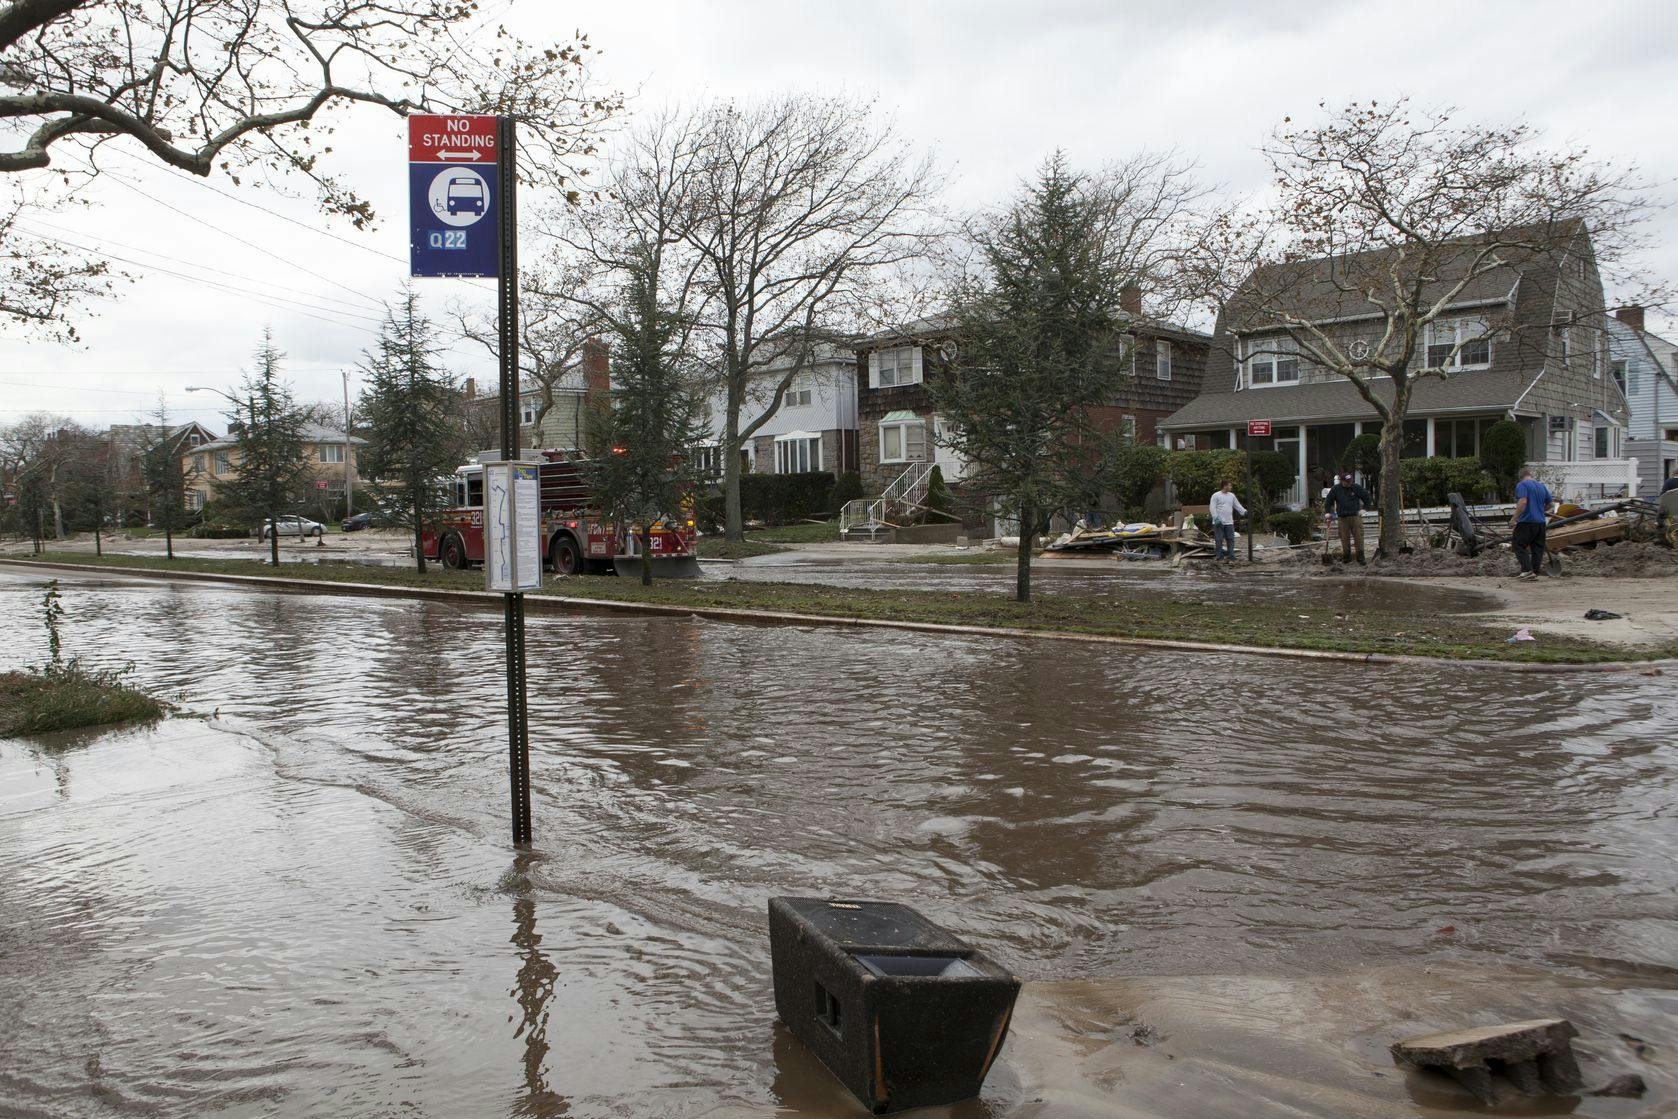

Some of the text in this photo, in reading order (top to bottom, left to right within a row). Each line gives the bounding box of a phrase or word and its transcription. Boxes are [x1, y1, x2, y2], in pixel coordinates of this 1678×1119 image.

[447, 119, 470, 132] NO
[423, 134, 495, 147] STANDING
[429, 231, 466, 248] Q22
[471, 511, 483, 525] 321
[649, 536, 663, 550] 321
